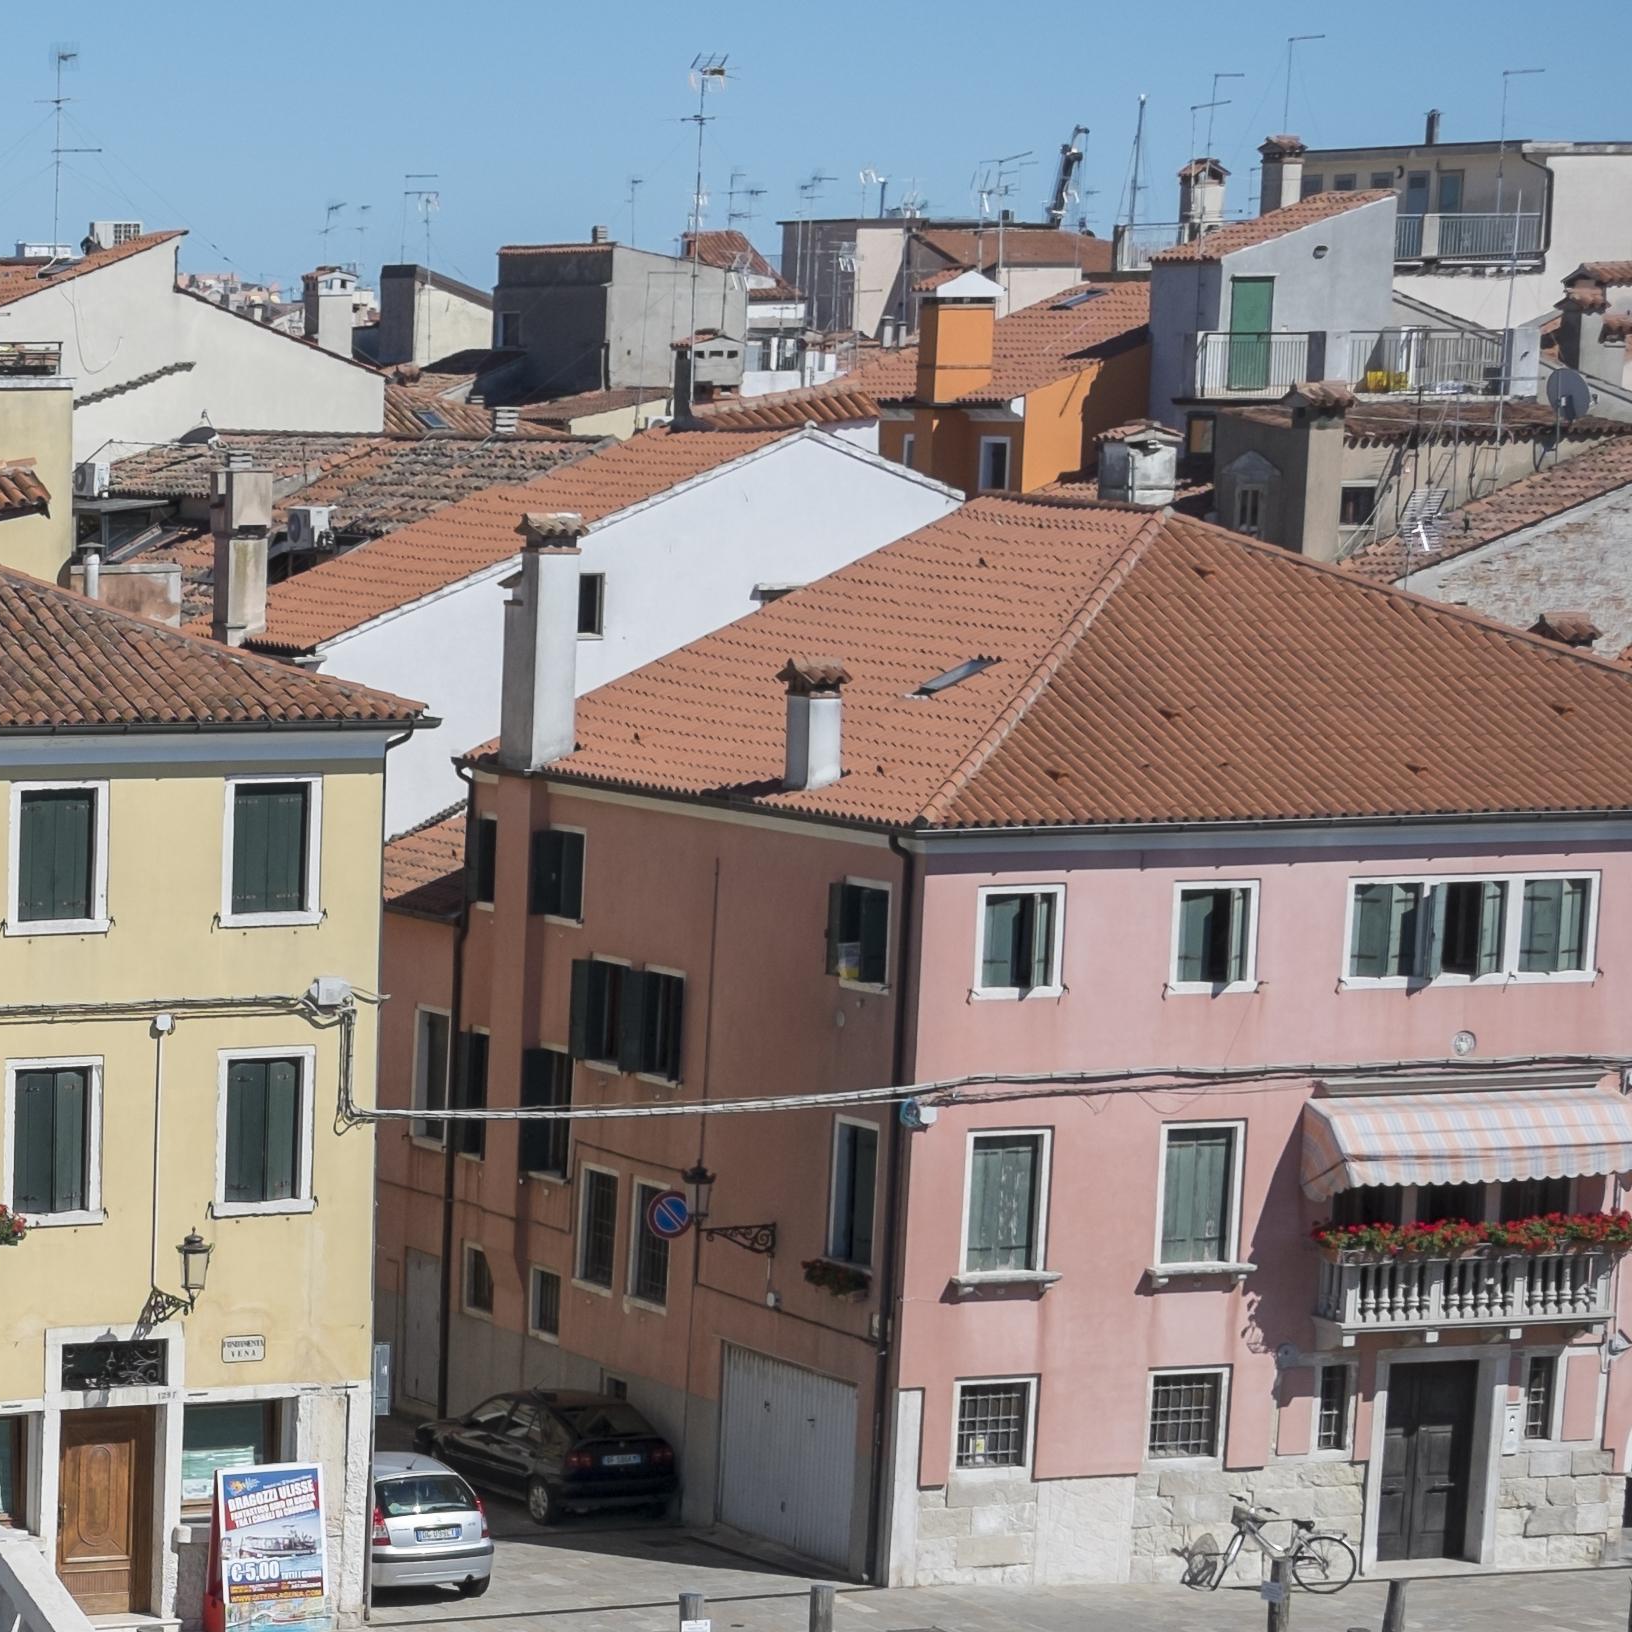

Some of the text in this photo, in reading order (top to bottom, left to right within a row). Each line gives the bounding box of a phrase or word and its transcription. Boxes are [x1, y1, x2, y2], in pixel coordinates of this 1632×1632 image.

[230, 1349, 257, 1358] VENA
[228, 1487, 278, 1512] BRAGOZZI
[278, 1479, 315, 1500] ULISSE
